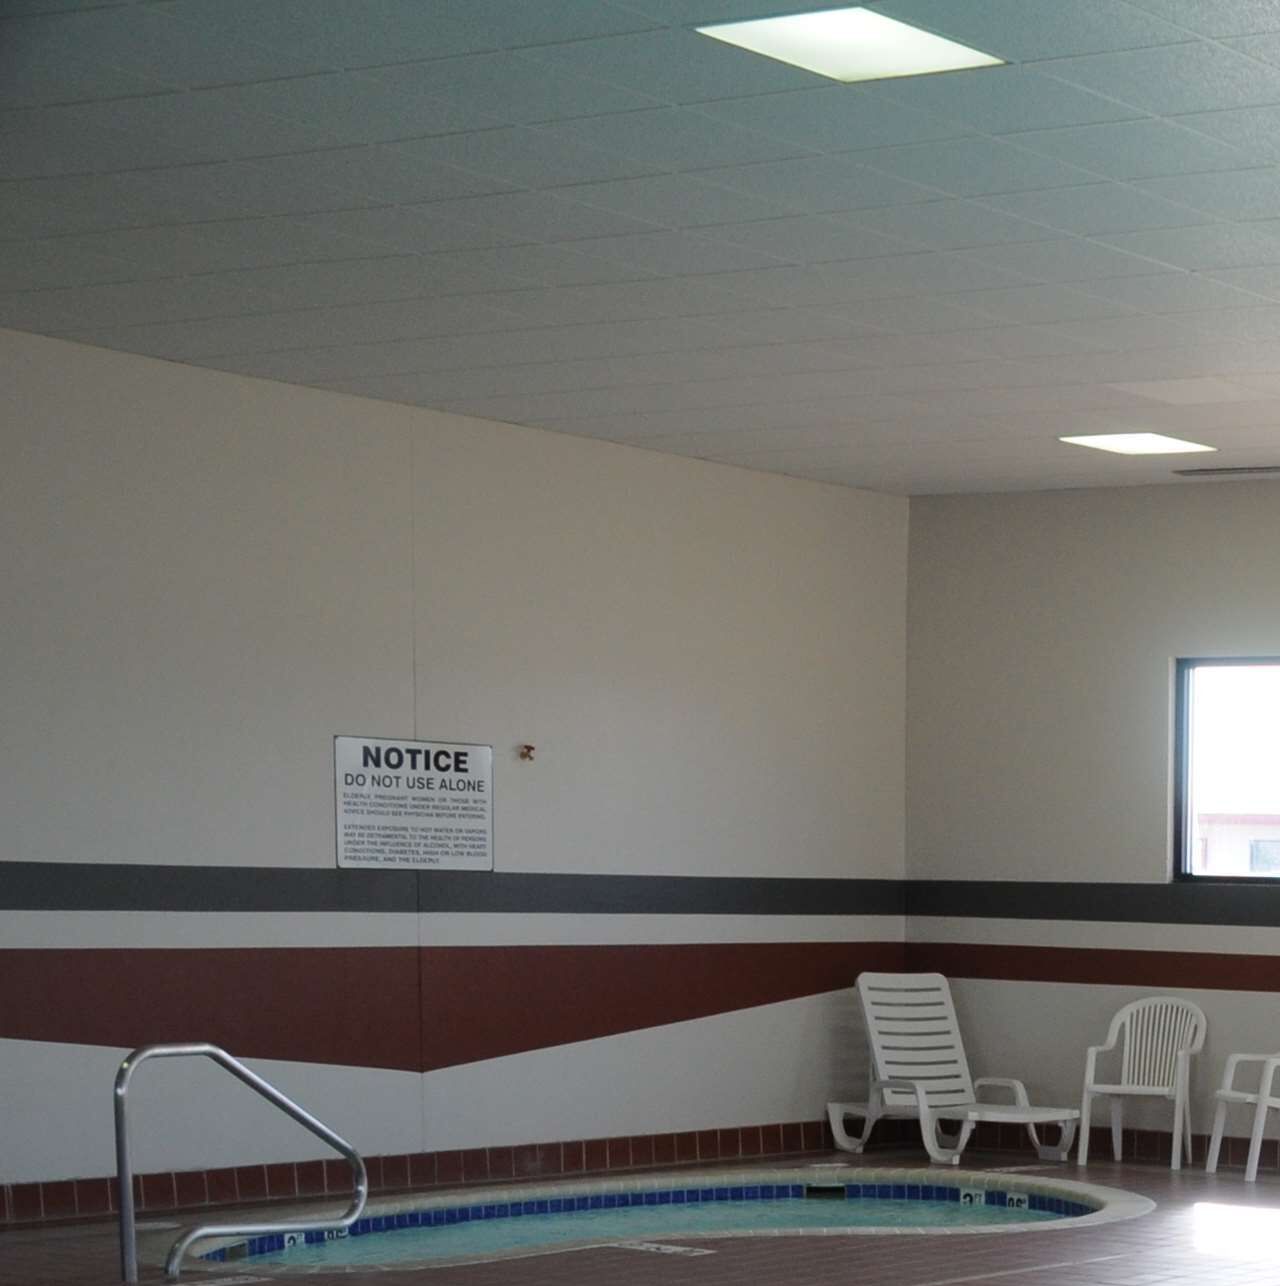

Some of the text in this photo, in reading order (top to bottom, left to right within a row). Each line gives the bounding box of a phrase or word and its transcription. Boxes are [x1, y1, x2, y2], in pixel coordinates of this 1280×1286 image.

[362, 745, 469, 773] NOTICE
[344, 773, 485, 792] DO NOT USE ALONE
